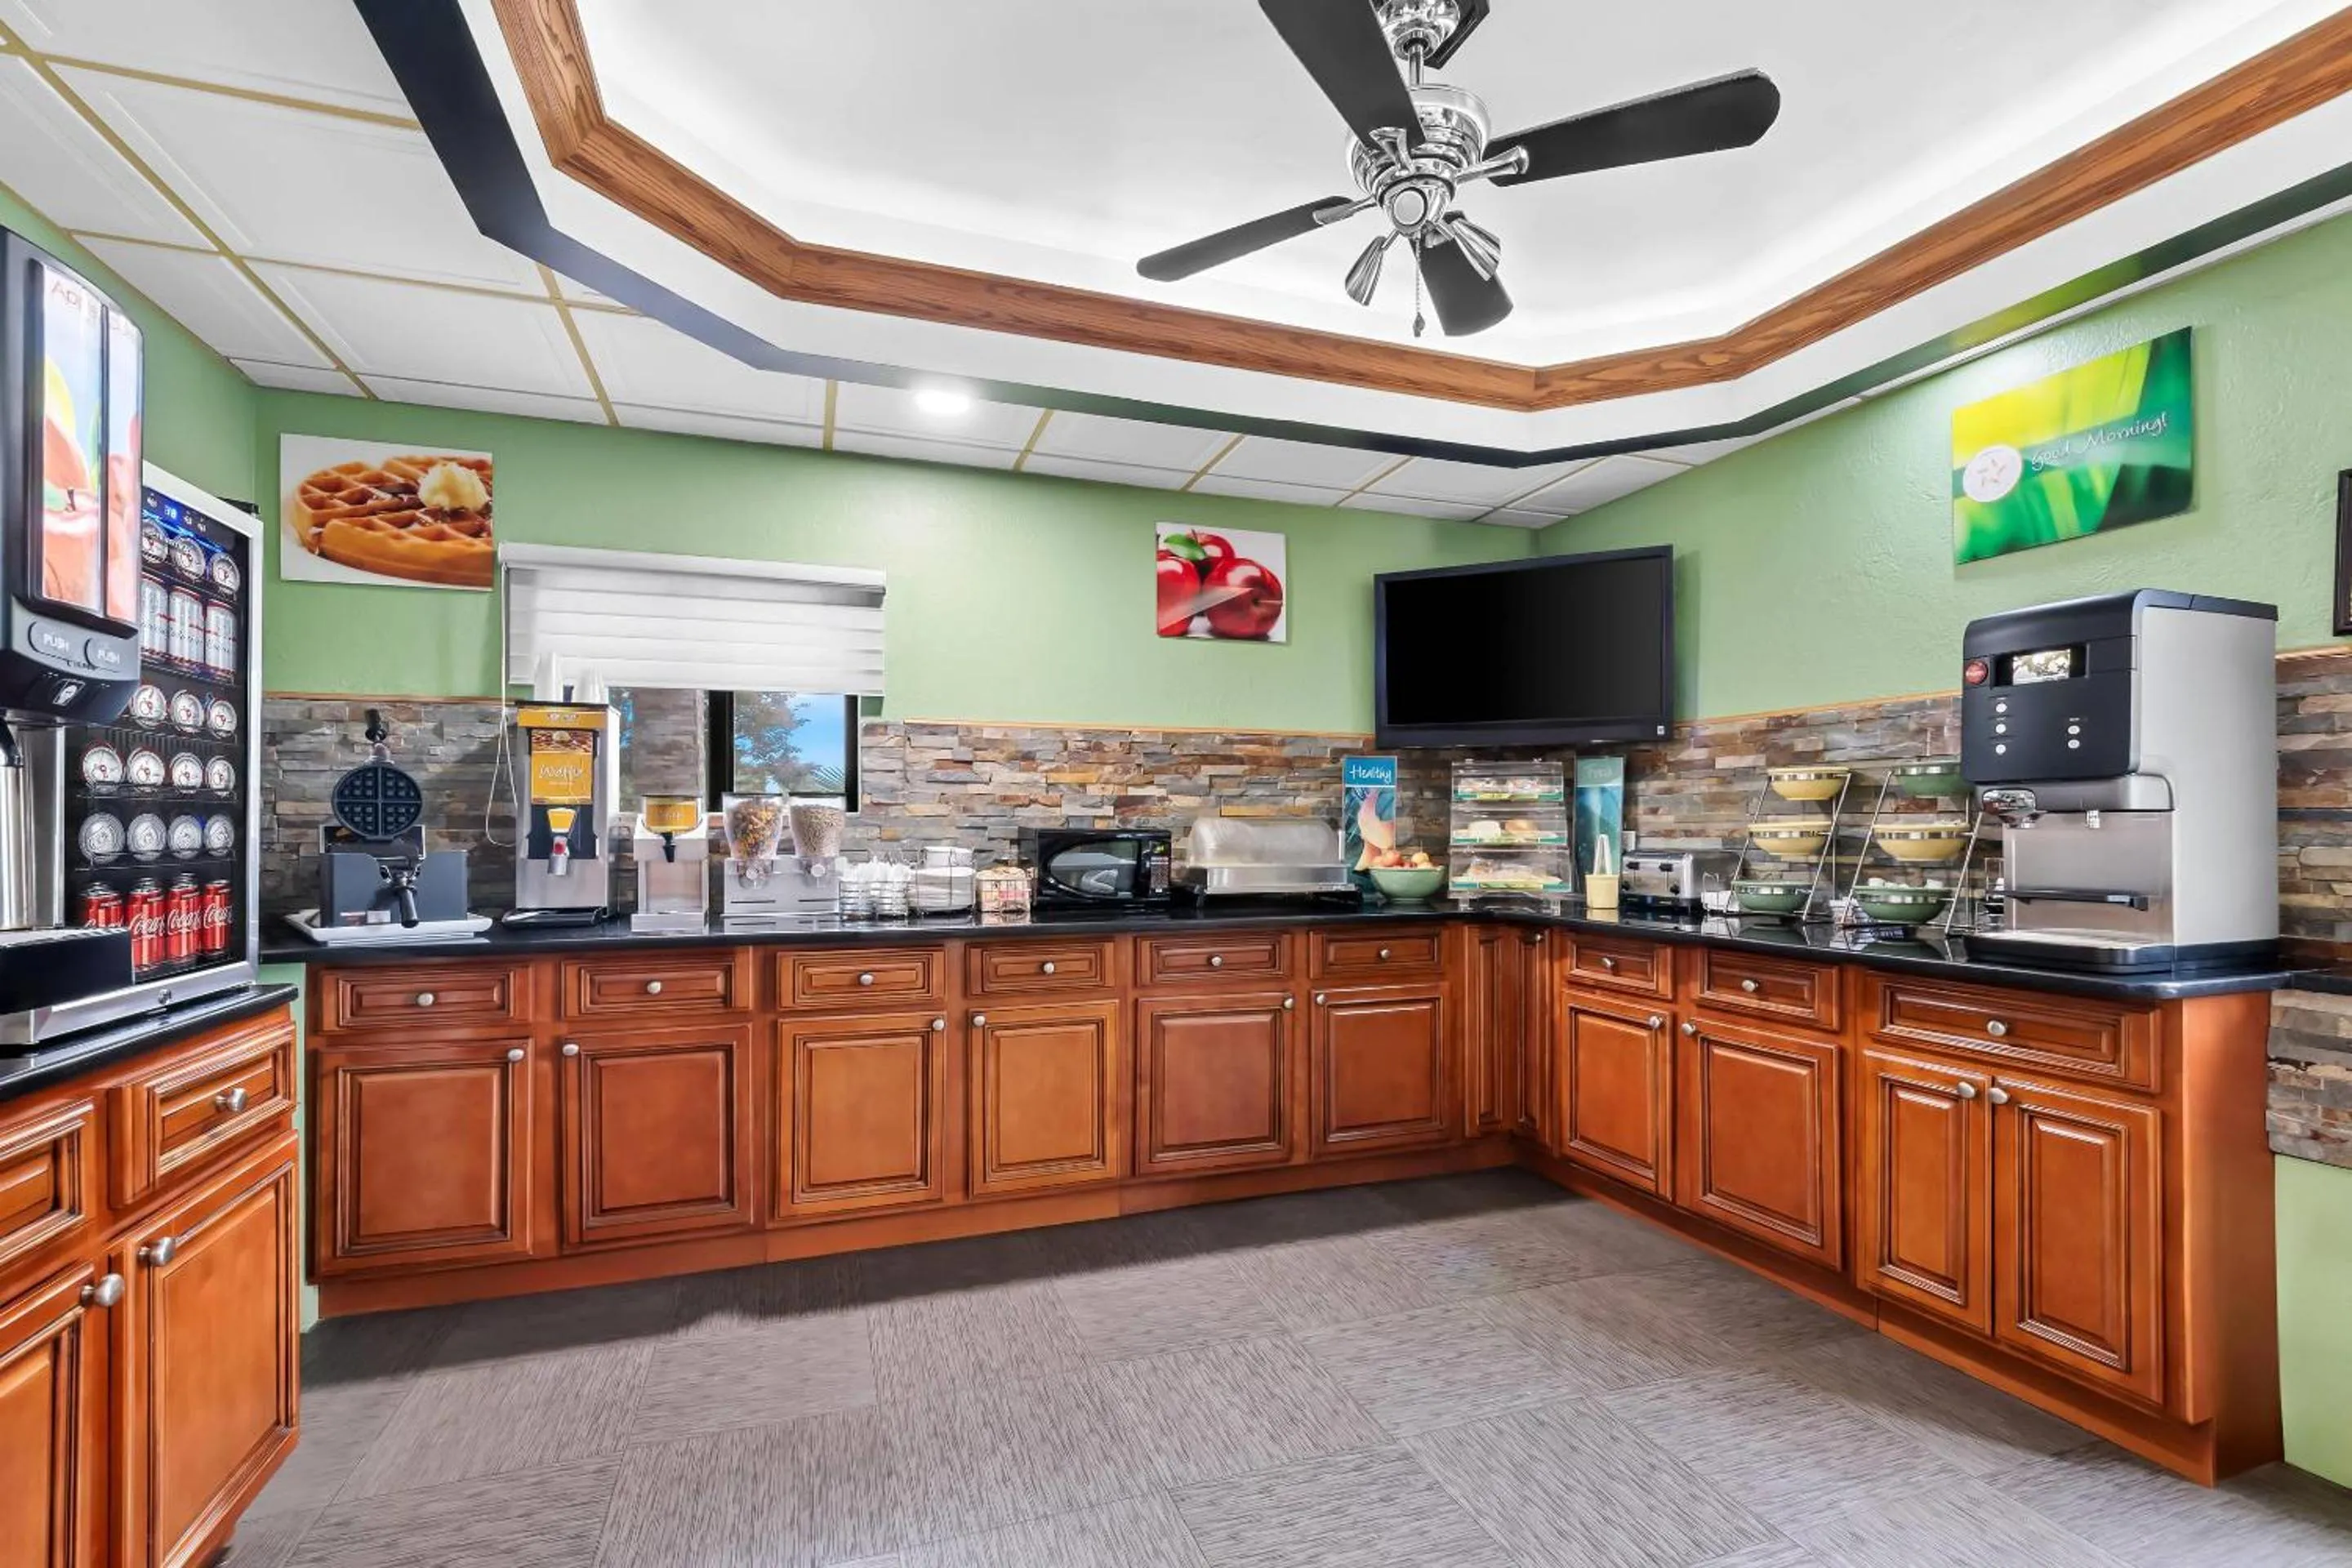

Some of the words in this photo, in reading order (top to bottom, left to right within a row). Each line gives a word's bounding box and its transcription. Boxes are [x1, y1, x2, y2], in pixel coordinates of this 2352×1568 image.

[2031, 439, 2072, 471] Good
[2075, 411, 2167, 453] Morning!
[1348, 764, 1392, 784] Healthy
